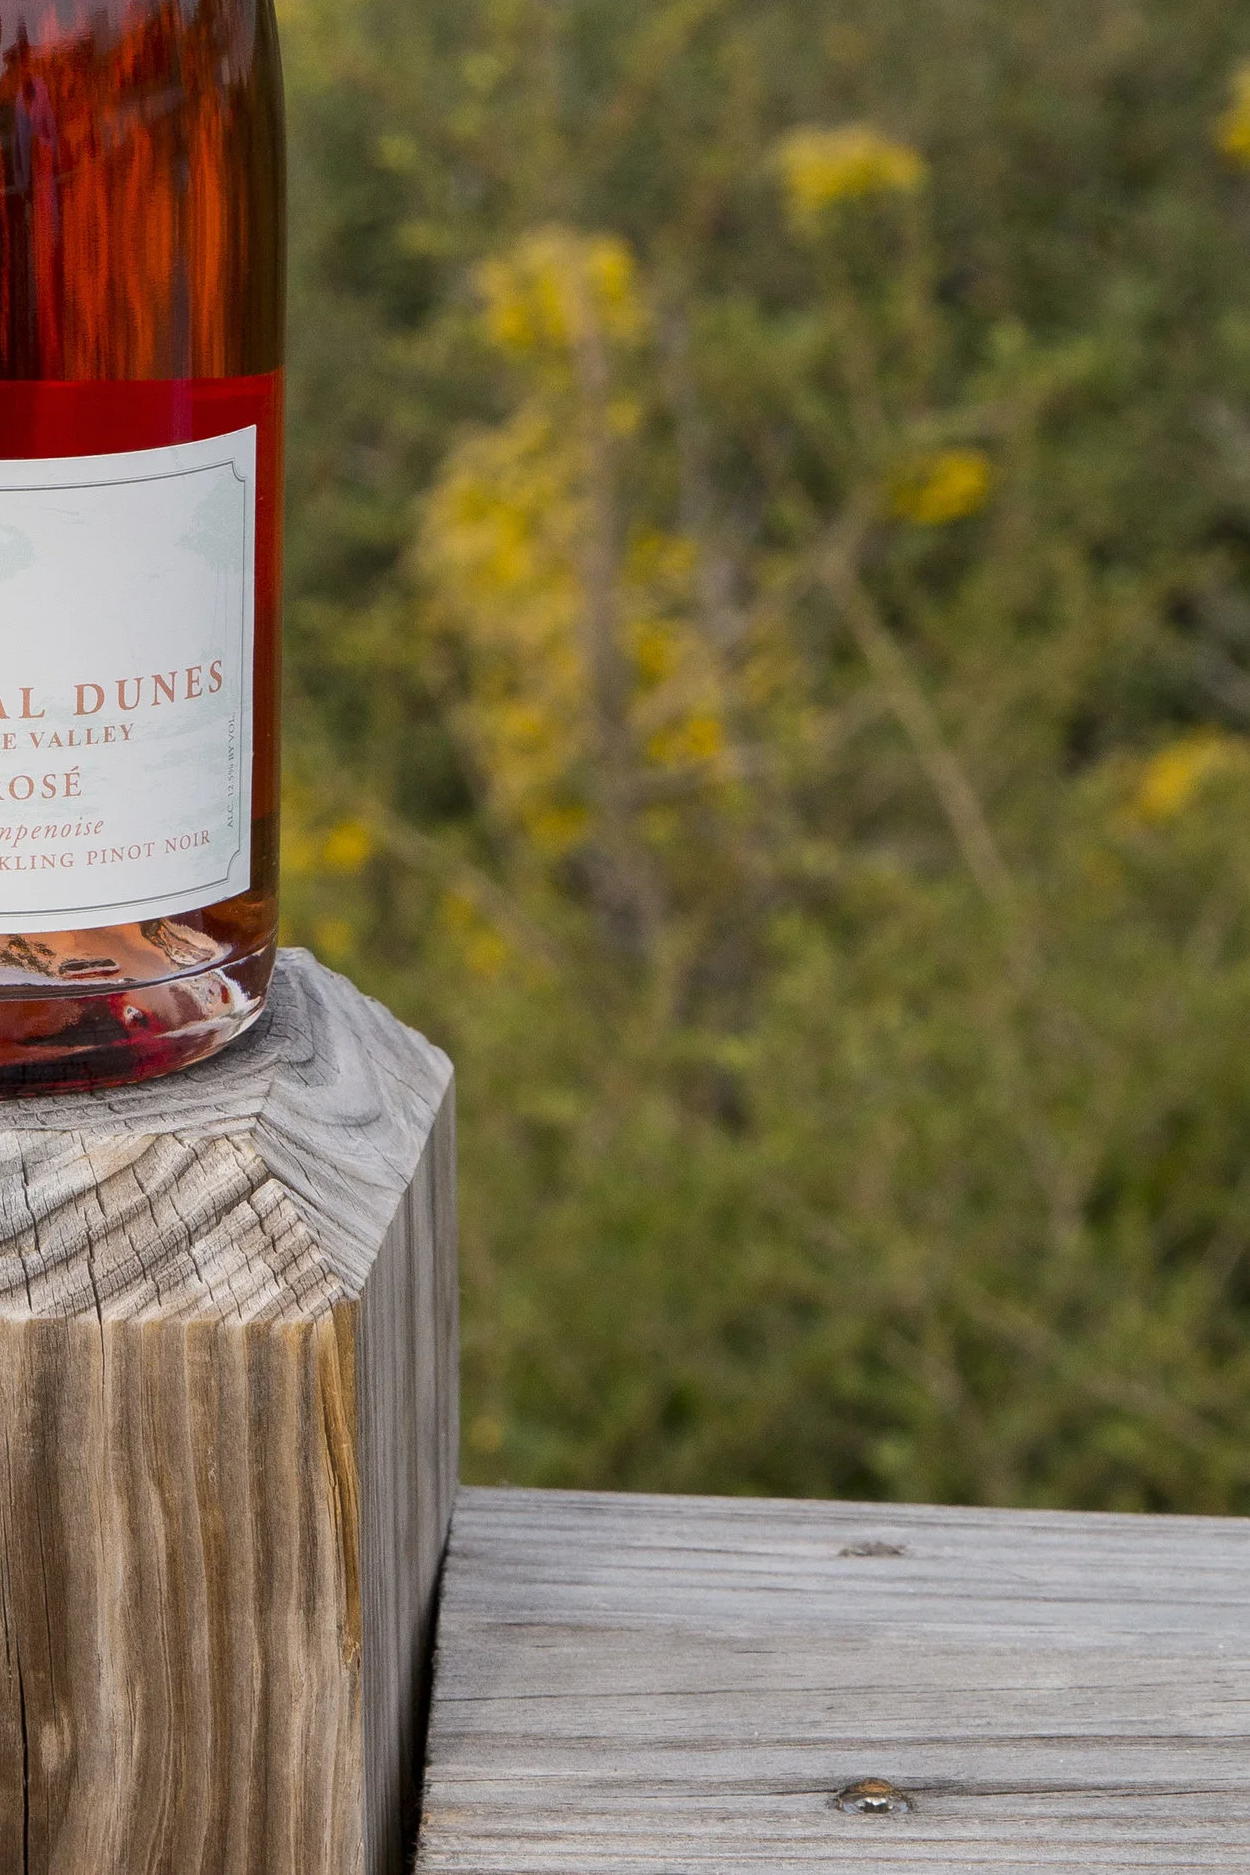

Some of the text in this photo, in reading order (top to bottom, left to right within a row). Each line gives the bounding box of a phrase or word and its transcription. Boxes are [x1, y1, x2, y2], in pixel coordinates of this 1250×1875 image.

[73, 660, 224, 717] DUNES
[29, 723, 135, 750] VALLEY
[228, 745, 235, 761] BY
[87, 841, 155, 866] PINOT
[165, 829, 211, 854] NOIR
